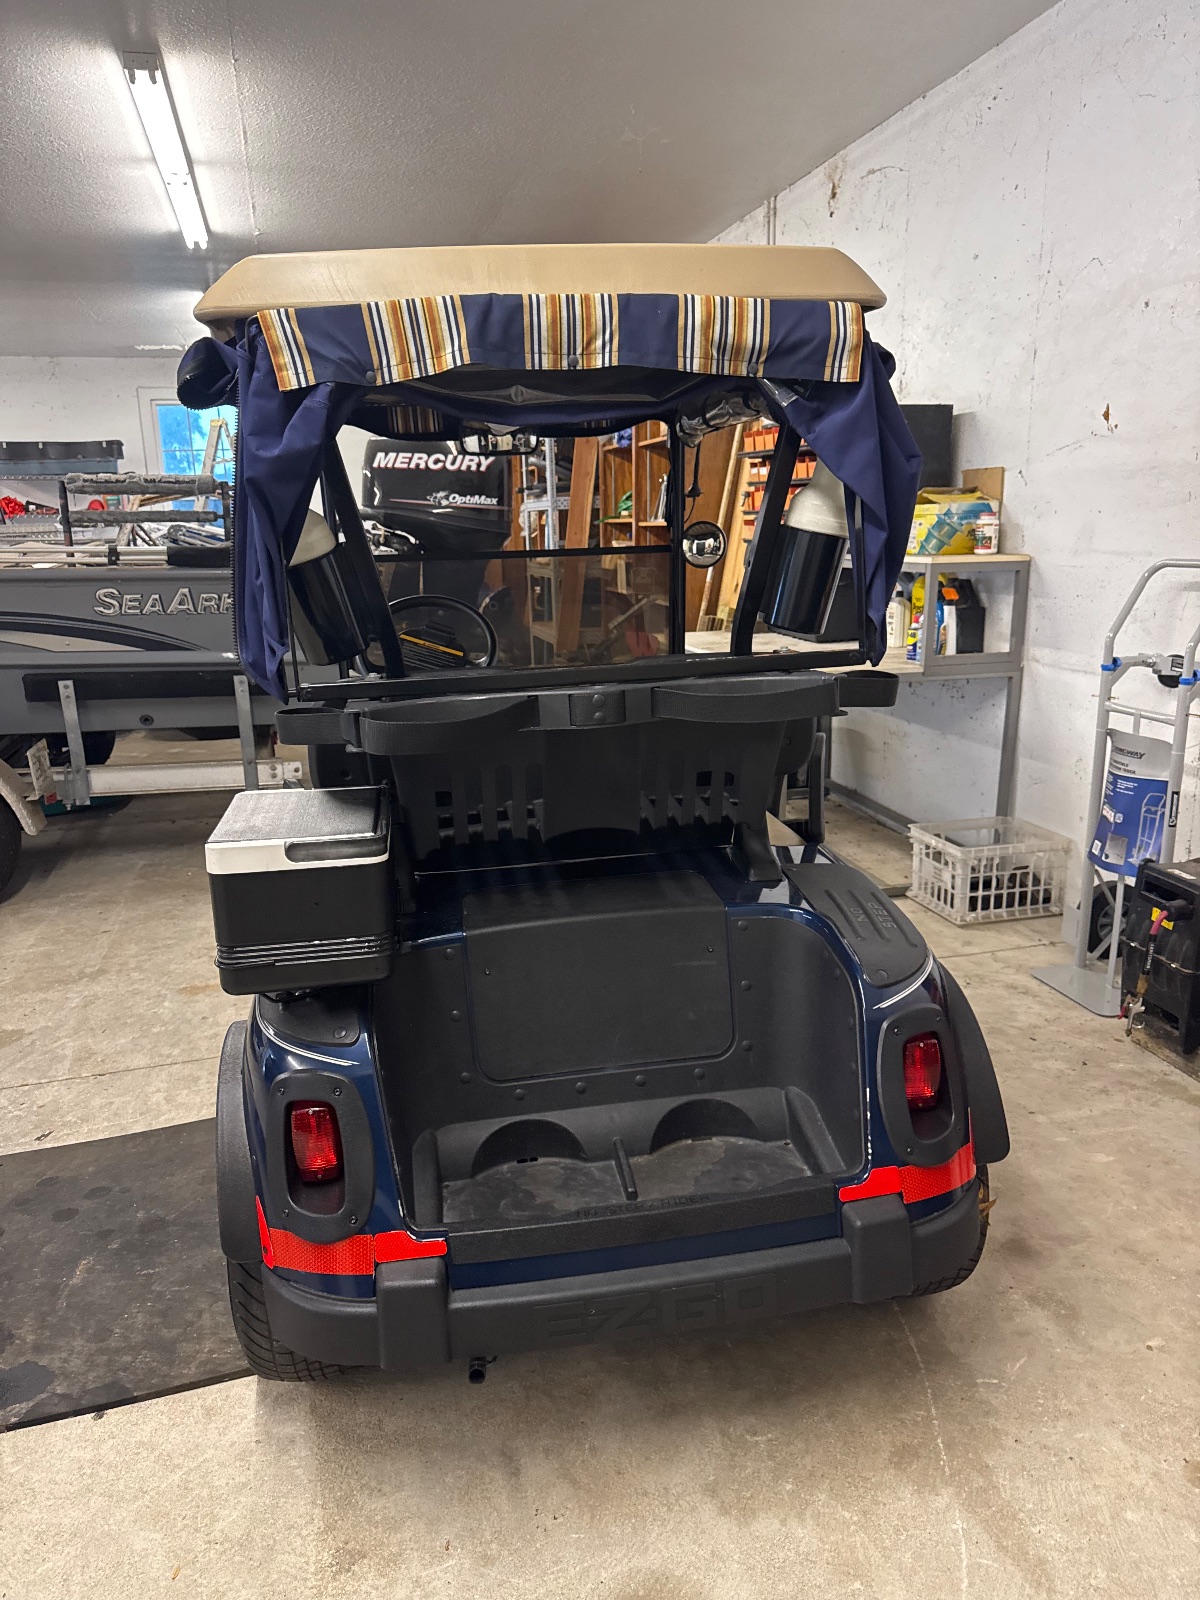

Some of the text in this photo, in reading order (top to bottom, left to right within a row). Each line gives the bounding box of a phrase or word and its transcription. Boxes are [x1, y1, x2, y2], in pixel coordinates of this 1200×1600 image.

[372, 451, 496, 472] MERCURY
[448, 493, 499, 505] OptiMax
[850, 908, 868, 922] NO
[868, 902, 896, 929] STEP
[661, 1194, 710, 1207] RIDER
